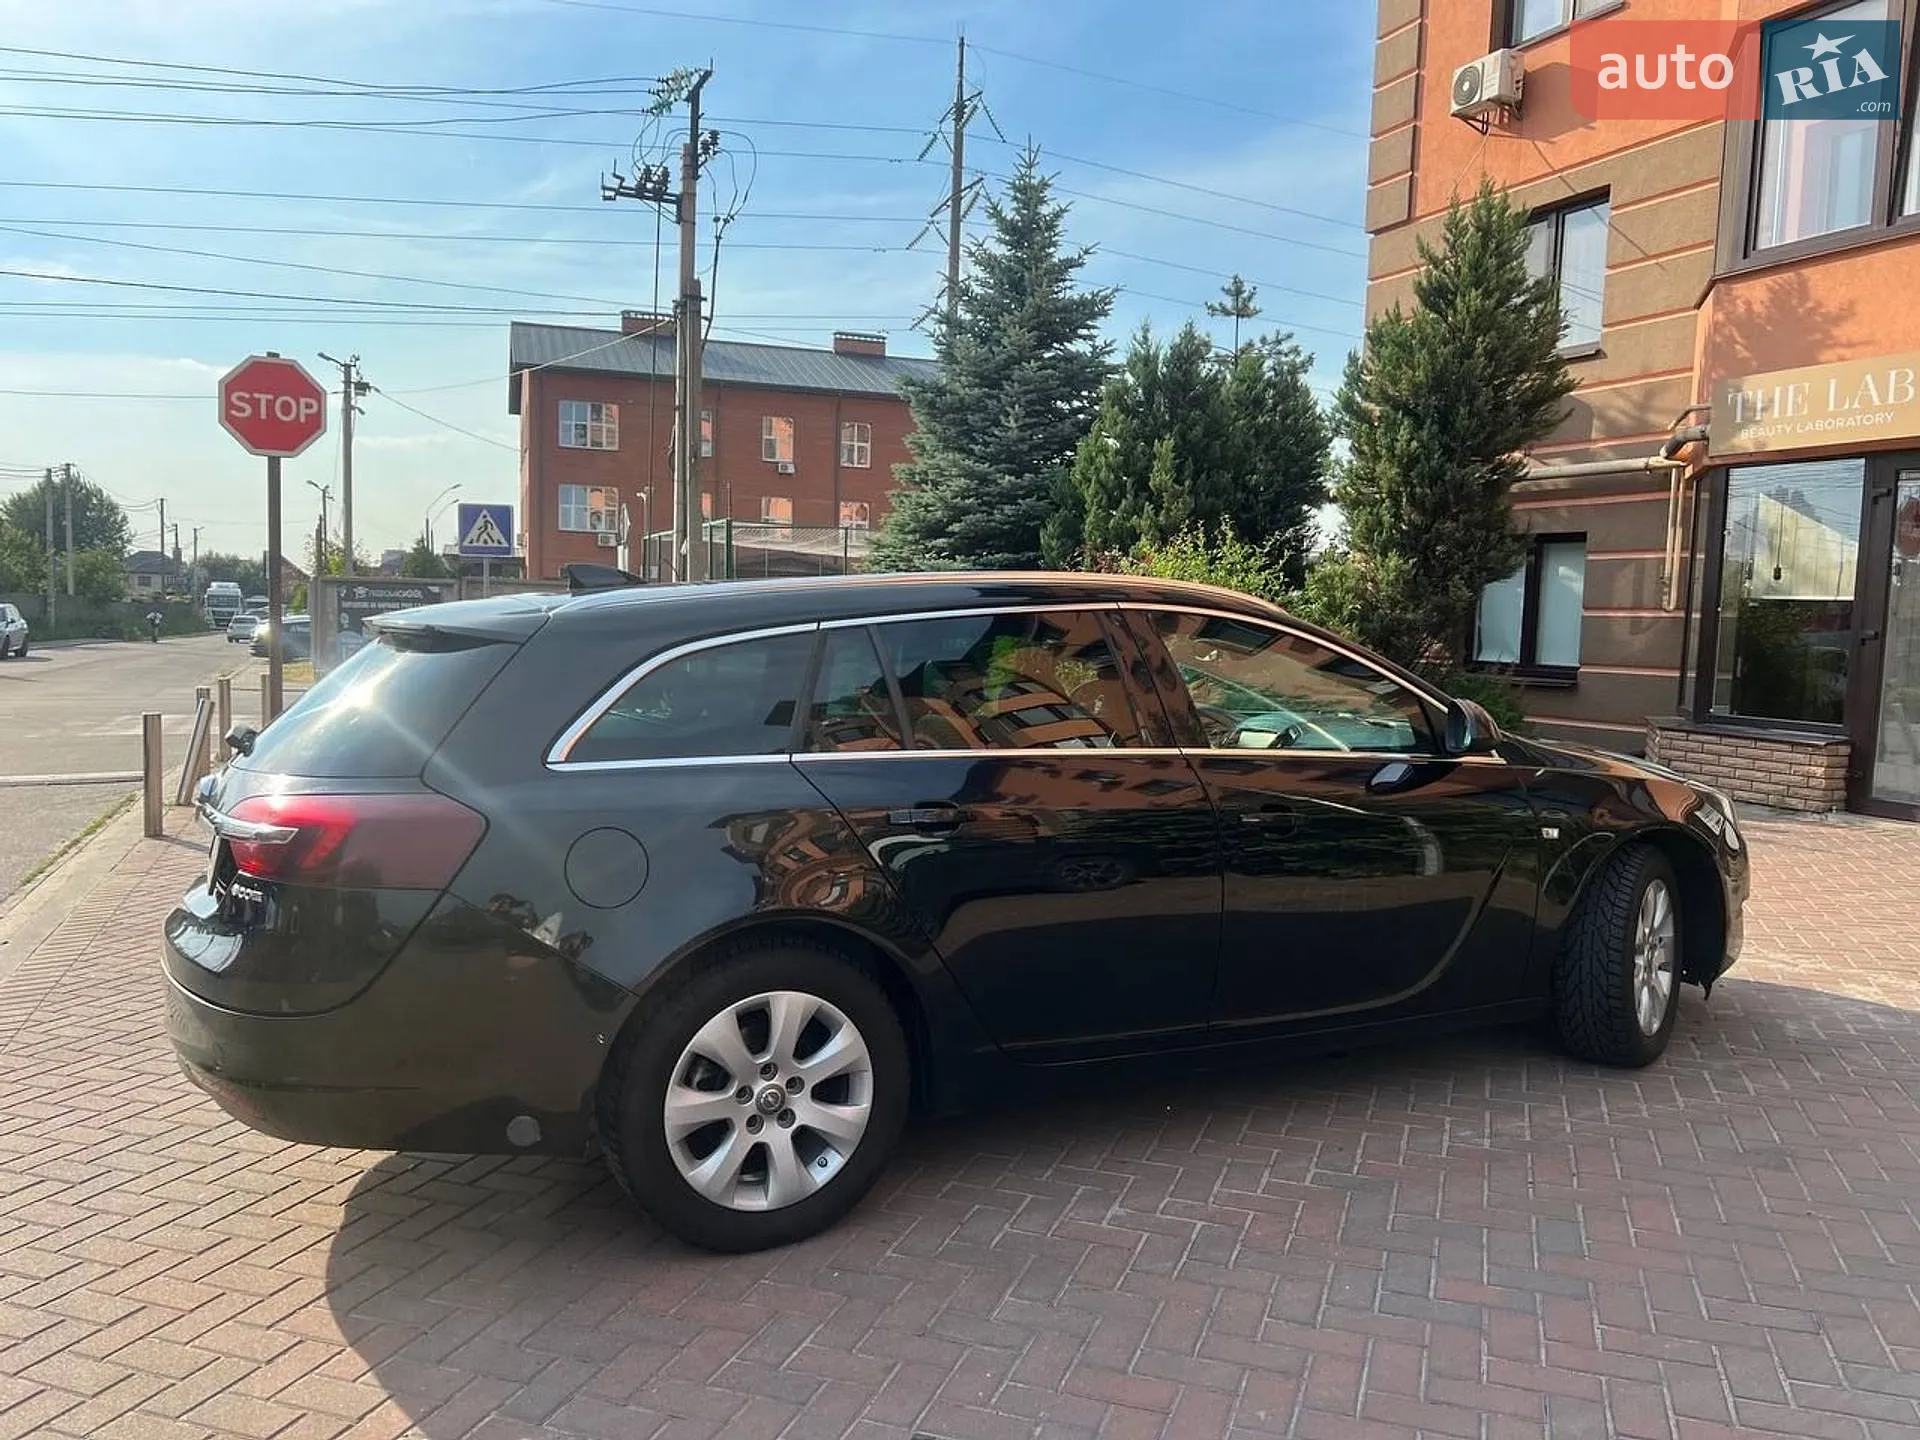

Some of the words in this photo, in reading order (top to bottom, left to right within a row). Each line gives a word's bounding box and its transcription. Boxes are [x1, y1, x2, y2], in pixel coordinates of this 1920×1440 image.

[230, 391, 319, 423] STOP
[1728, 382, 1809, 423] THE
[1827, 368, 1915, 412] LAB
[1741, 422, 1794, 440] BEAUTY
[1797, 411, 1896, 432] LABORATORY
